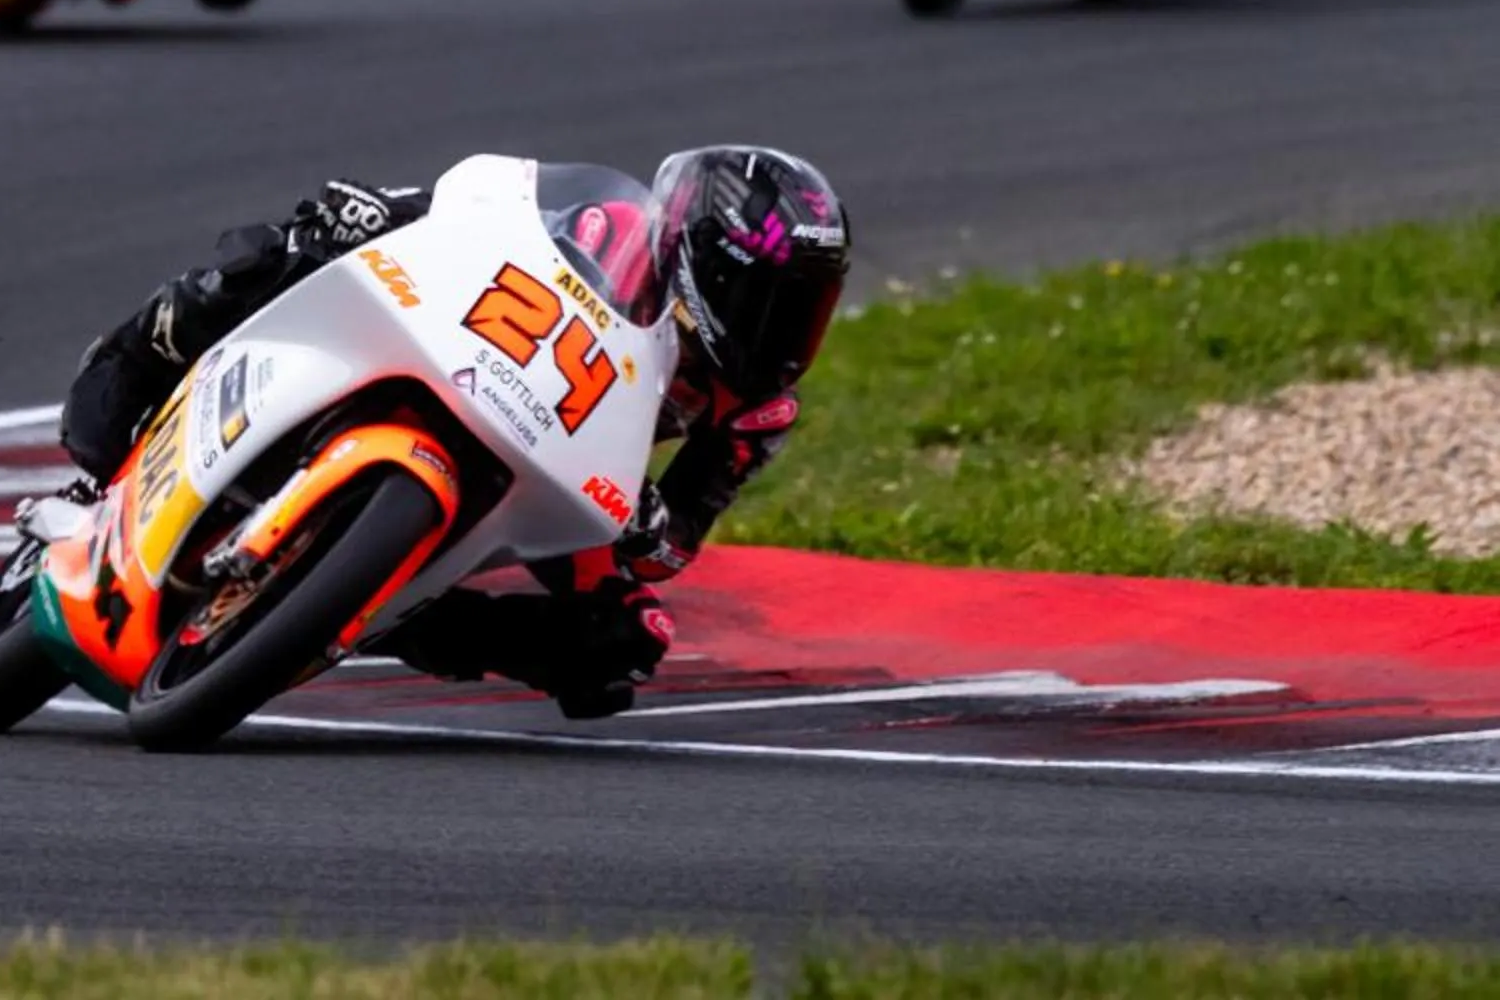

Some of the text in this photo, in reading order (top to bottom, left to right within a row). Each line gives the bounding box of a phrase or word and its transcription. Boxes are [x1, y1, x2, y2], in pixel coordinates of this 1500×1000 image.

[357, 249, 421, 308] KTM
[555, 271, 610, 330] ADAC
[462, 261, 618, 437] 24
[581, 475, 631, 524] KTM
